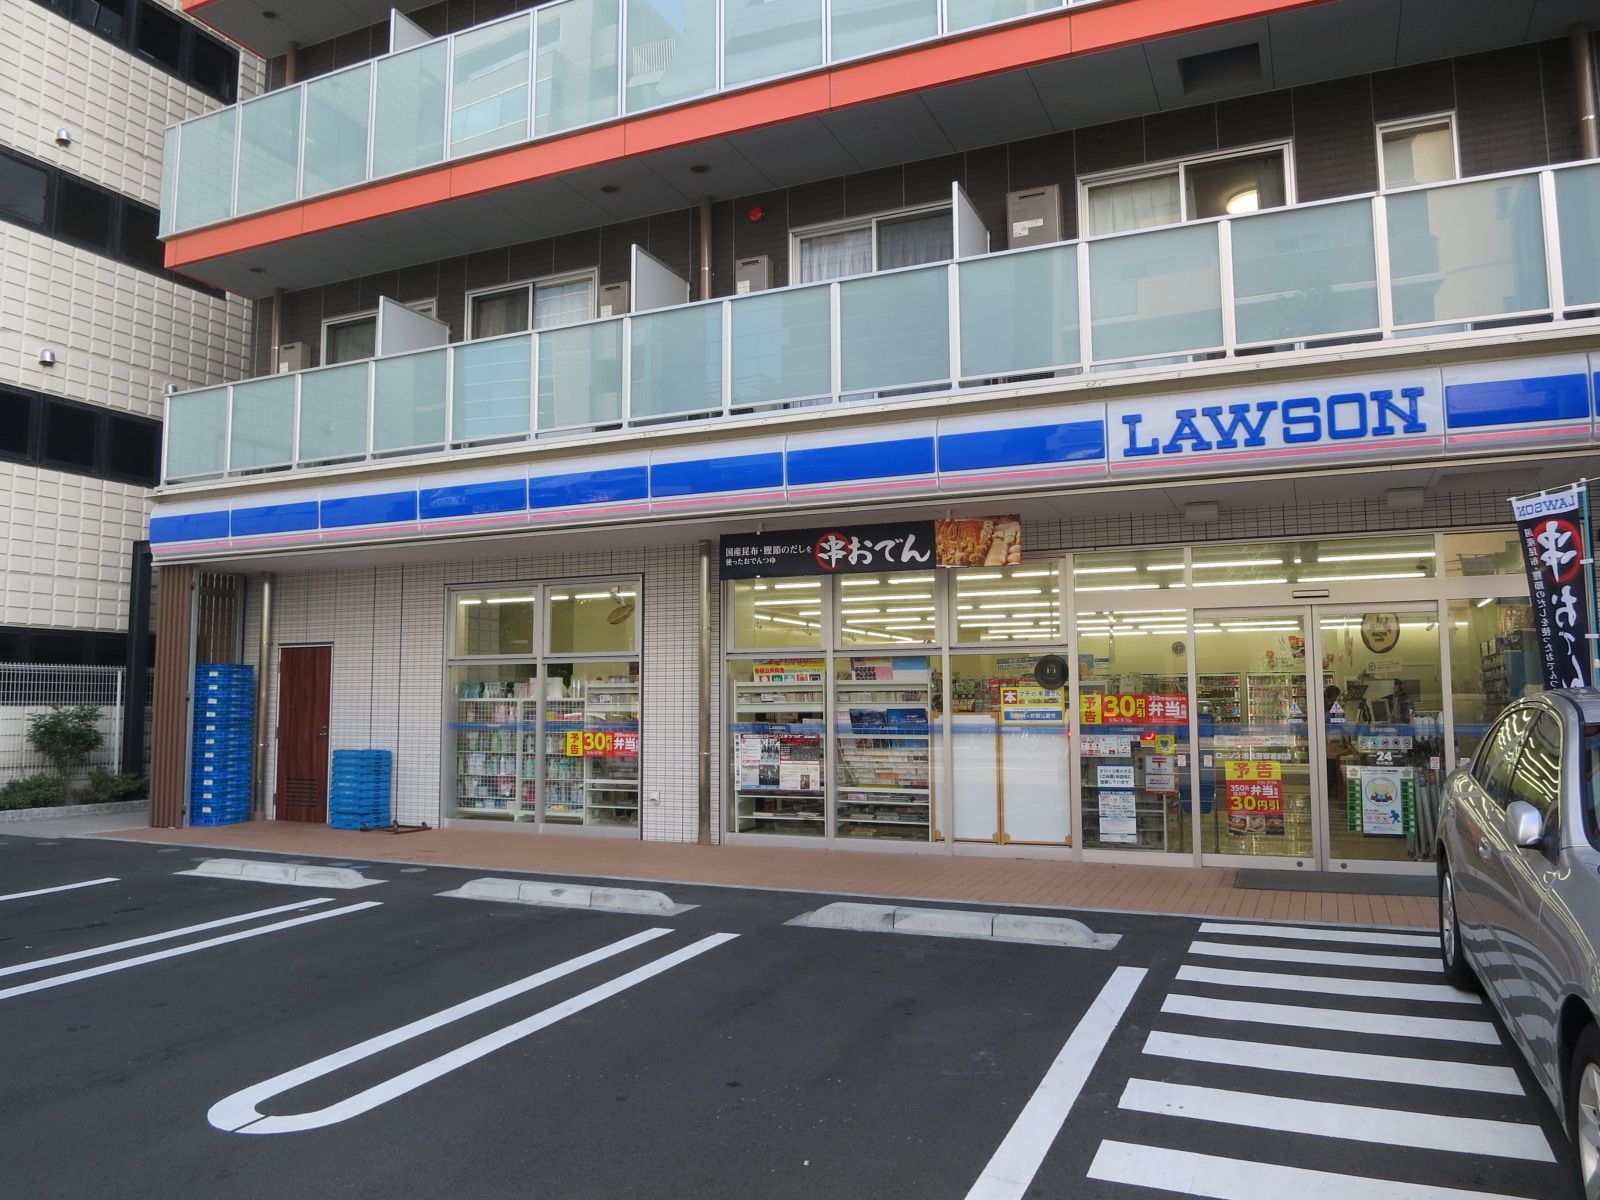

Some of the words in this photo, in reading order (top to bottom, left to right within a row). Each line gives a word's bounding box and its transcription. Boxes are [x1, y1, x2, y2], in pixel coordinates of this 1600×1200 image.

[1121, 386, 1427, 458] LAWSON
[817, 533, 931, 569] 串おでん
[1084, 696, 1097, 723] 予告
[570, 732, 580, 755] 予告
[1376, 751, 1393, 762] 24
[1233, 762, 1273, 779] 予告
